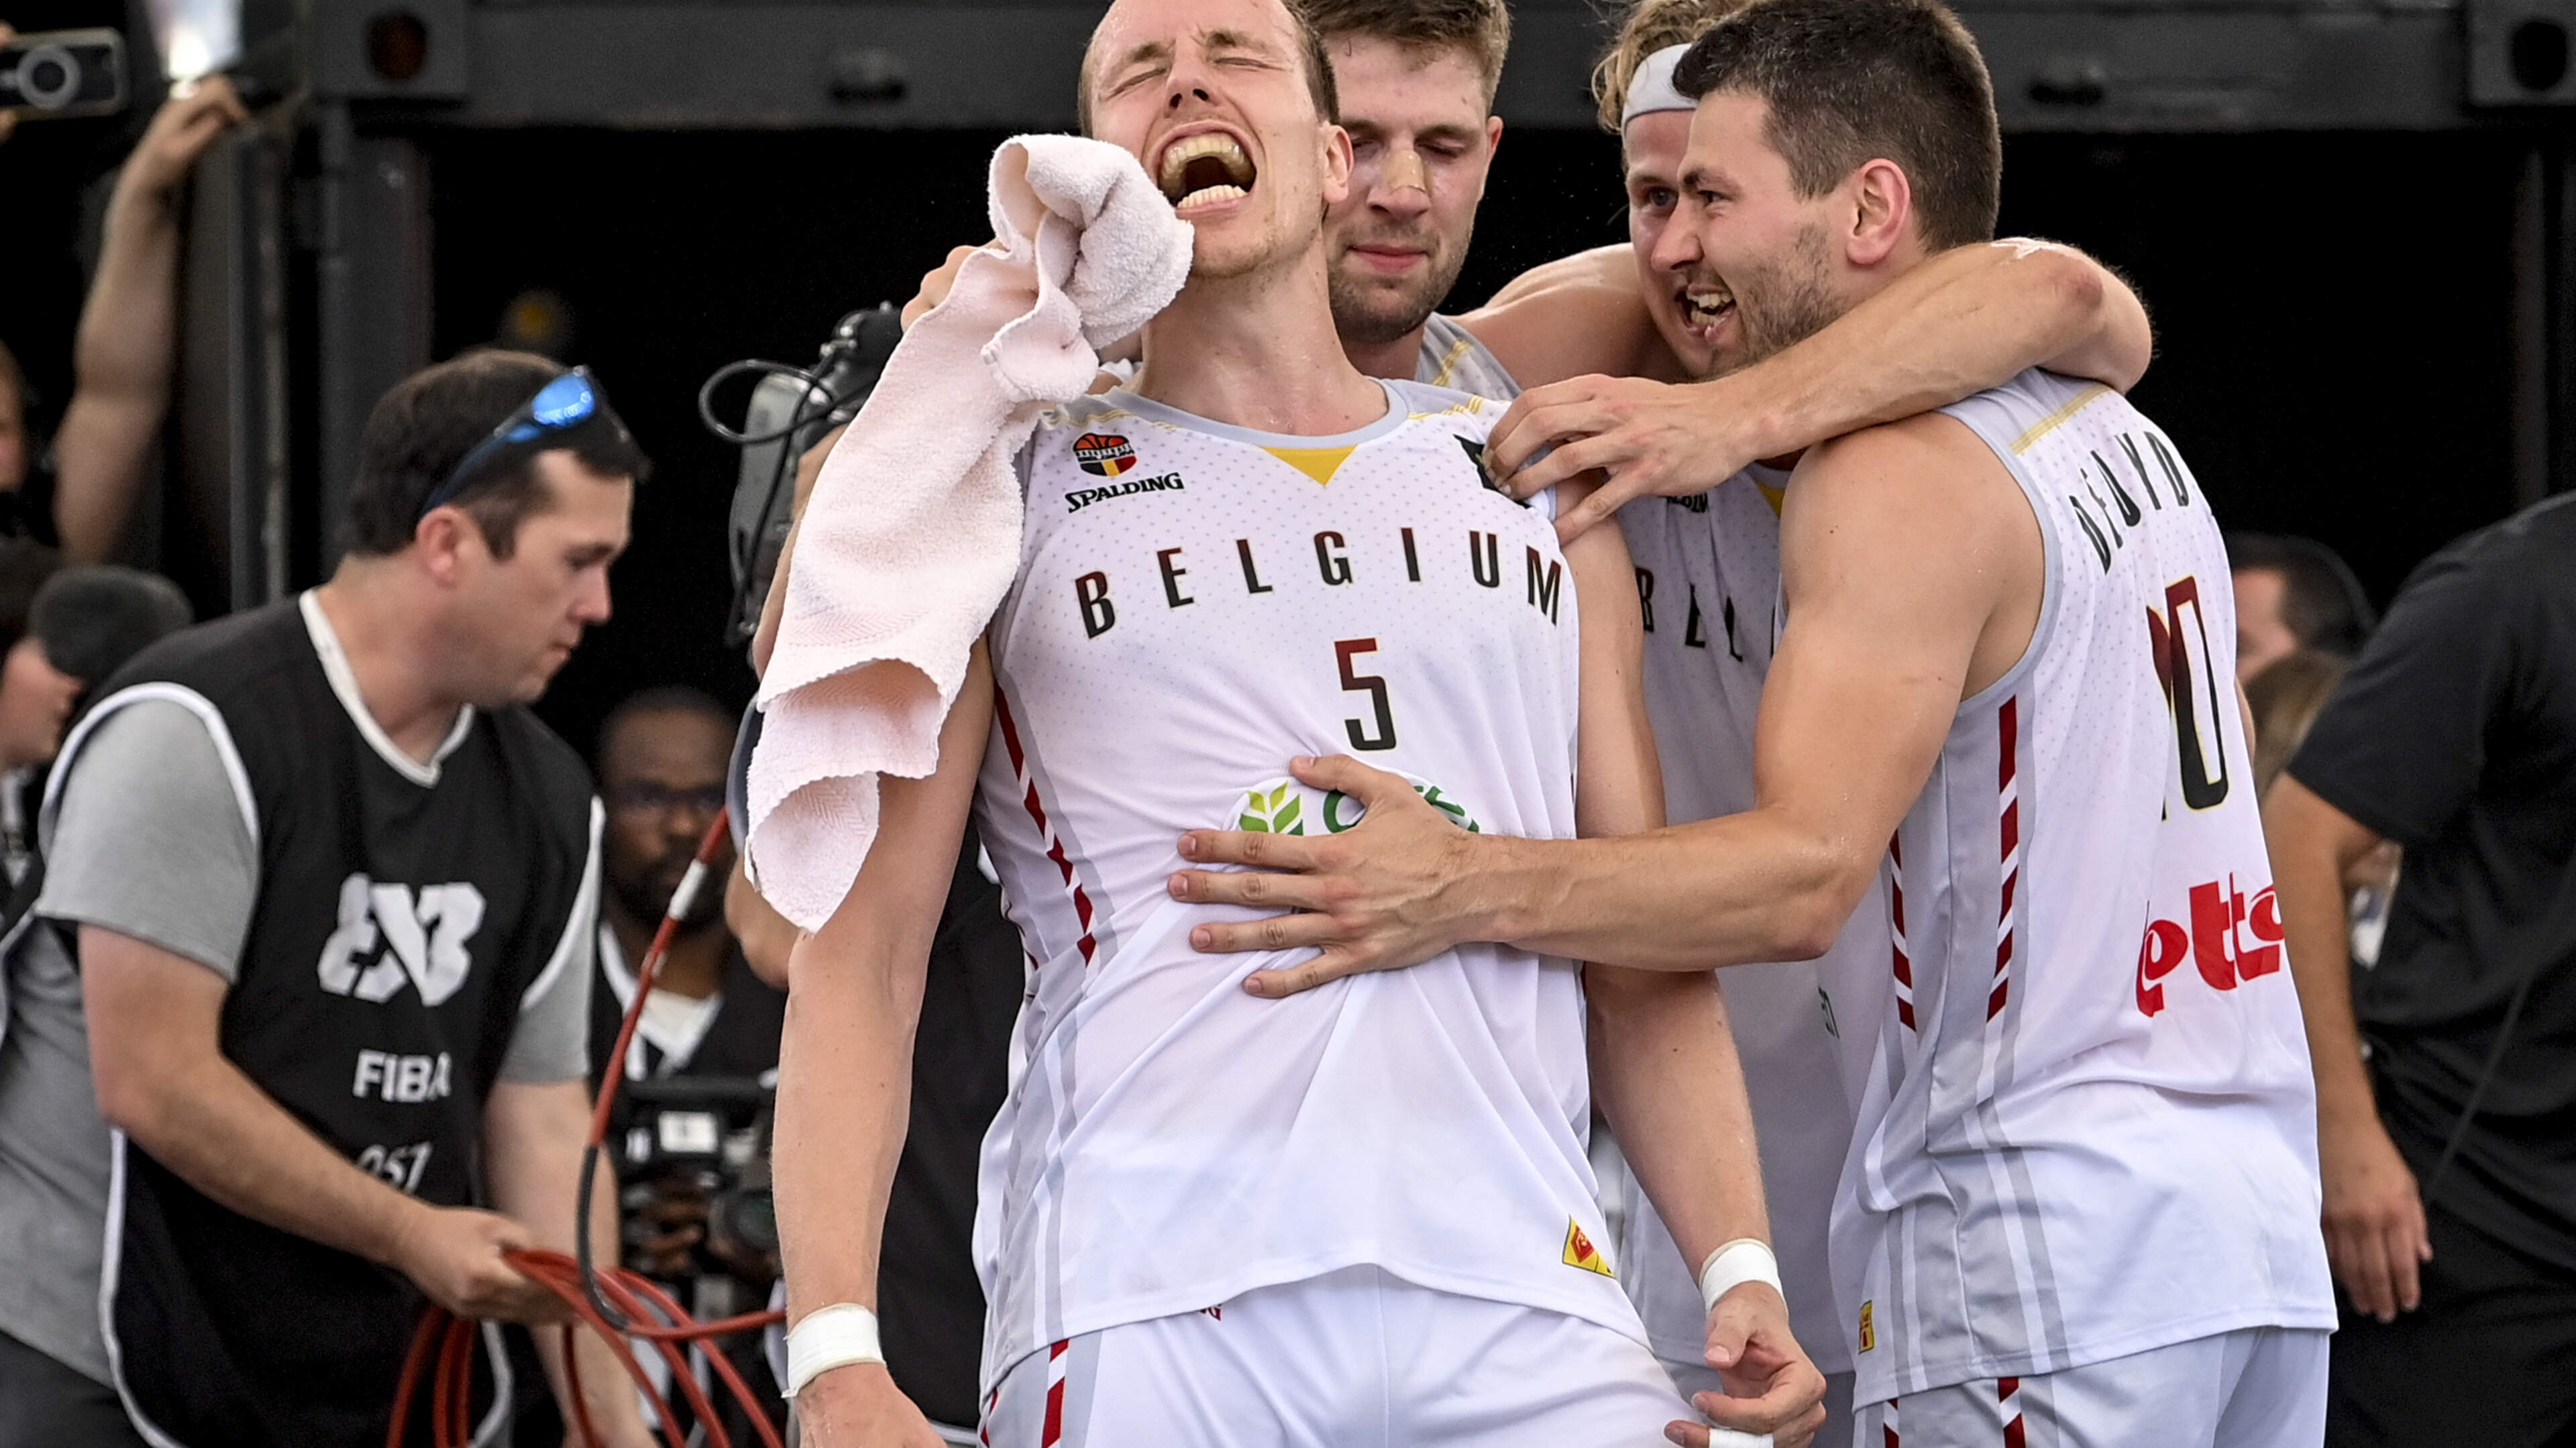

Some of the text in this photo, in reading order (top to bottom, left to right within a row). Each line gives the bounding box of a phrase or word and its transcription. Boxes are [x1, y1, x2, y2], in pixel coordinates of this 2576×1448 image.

[1065, 471, 1185, 514] SPALDING
[1074, 526, 1562, 640] BELGIUM
[1334, 637, 1397, 752] 5
[352, 1049, 451, 1103] FIBA
